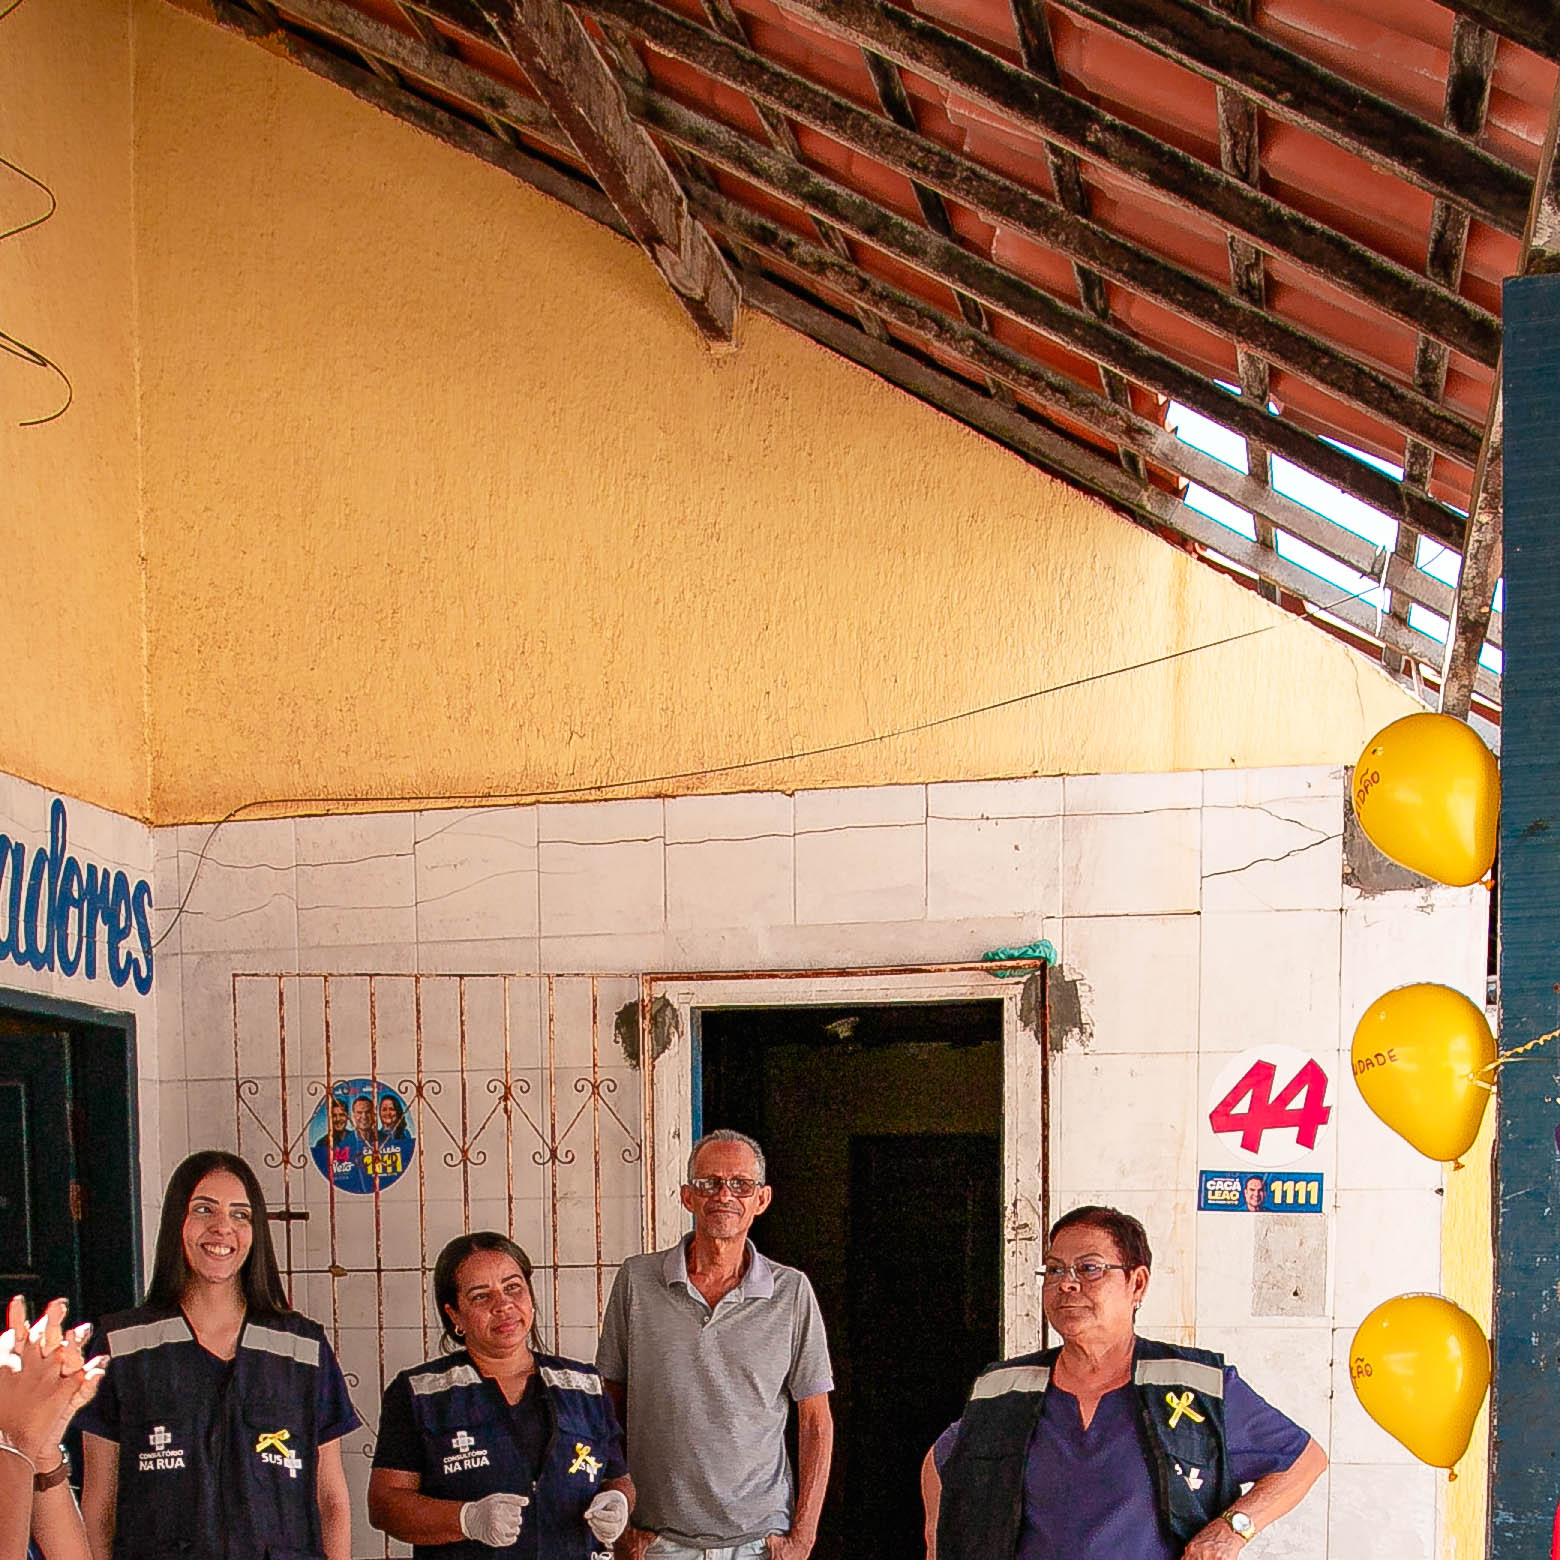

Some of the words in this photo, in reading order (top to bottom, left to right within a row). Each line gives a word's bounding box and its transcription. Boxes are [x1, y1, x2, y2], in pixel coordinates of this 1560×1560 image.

[1209, 1058, 1332, 1154] 44
[1270, 1180, 1319, 1205] 1111
[139, 1460, 154, 1471] NA
[156, 1457, 185, 1470] RUA
[261, 1453, 283, 1465] SUS
[443, 1462, 461, 1475] NA
[463, 1457, 490, 1470] RUA
